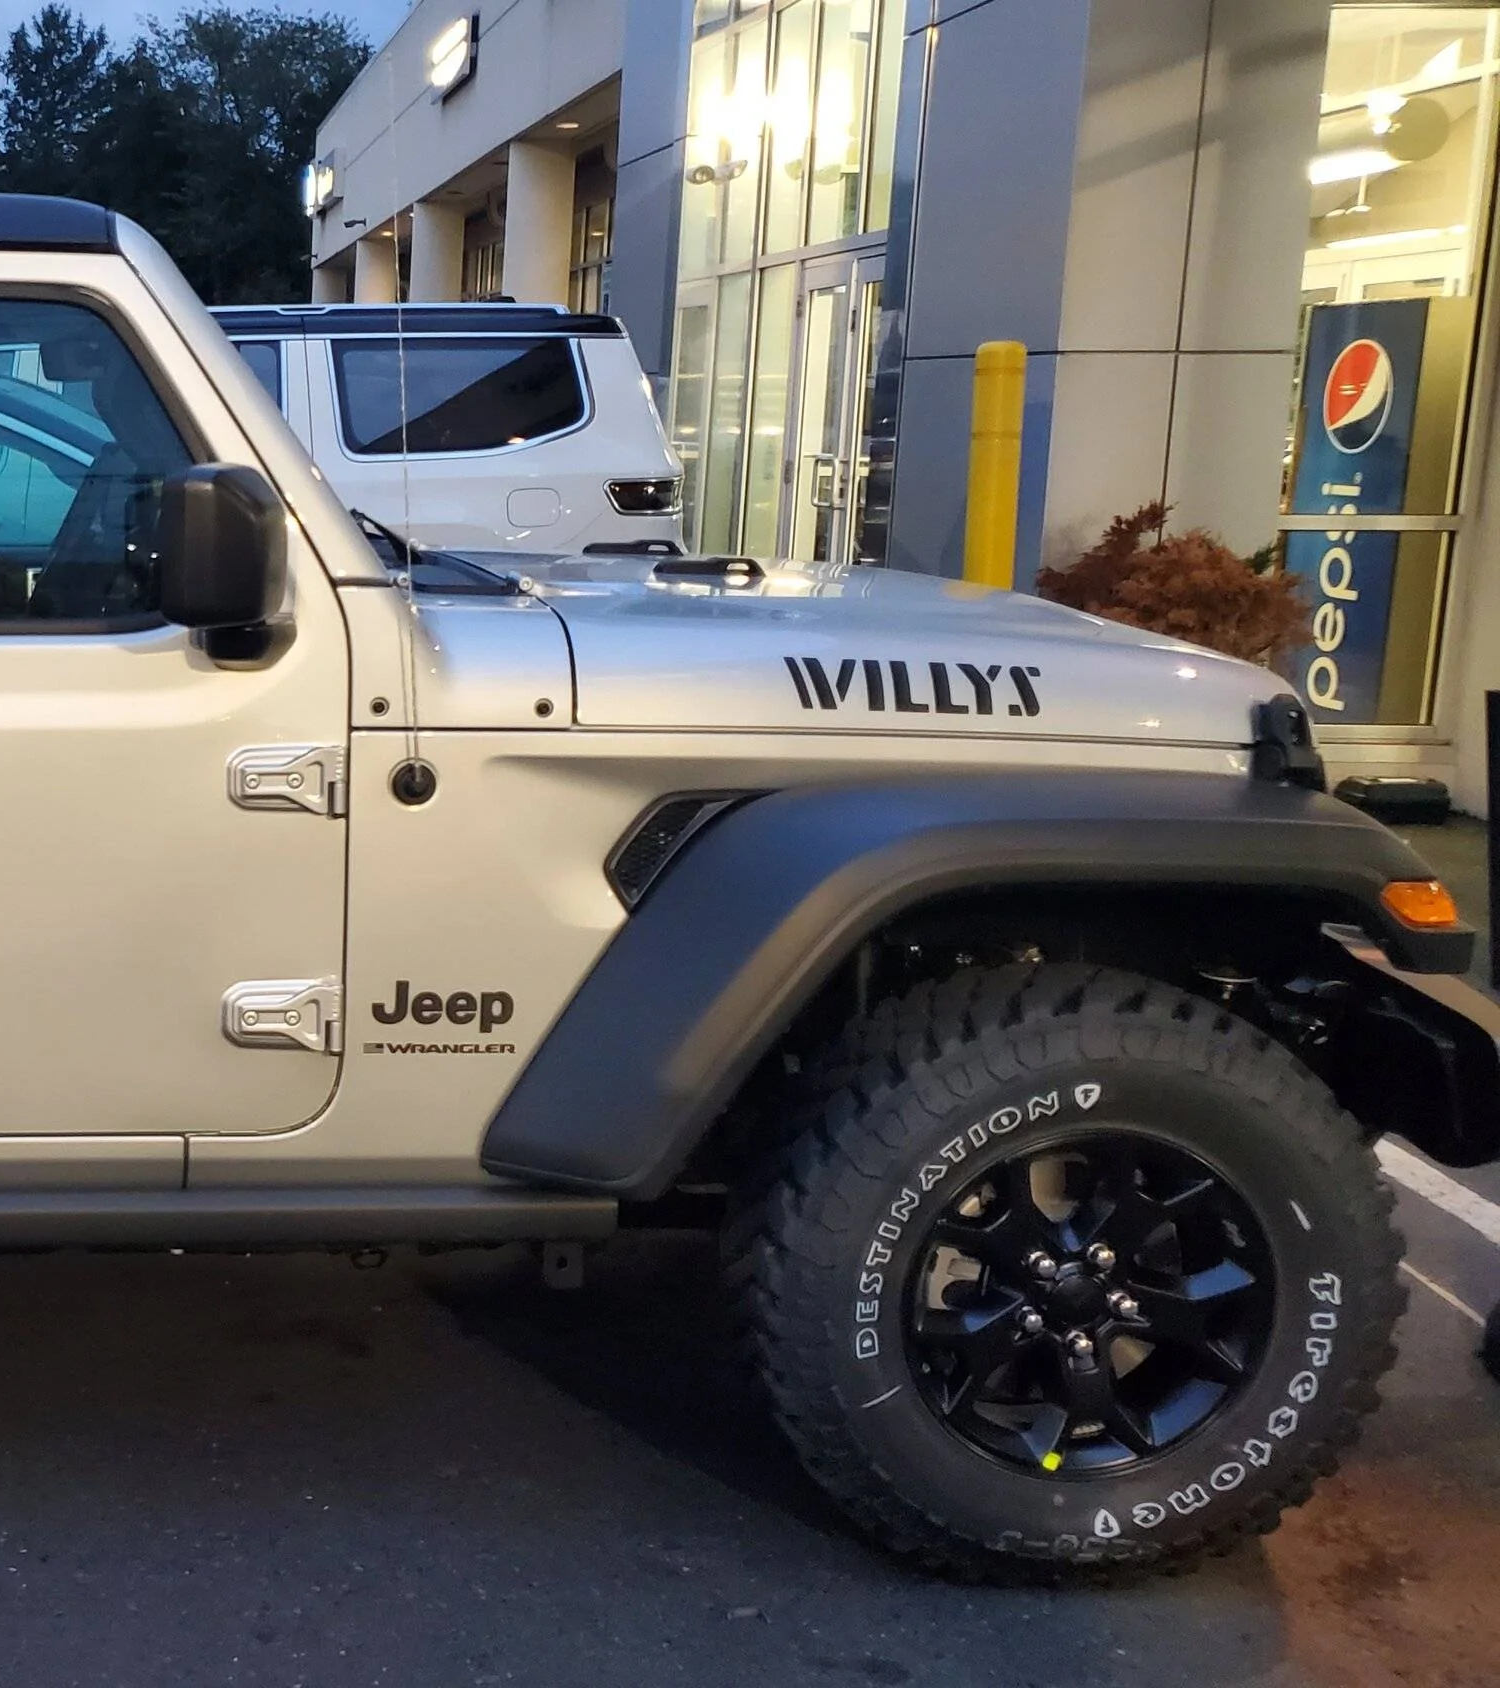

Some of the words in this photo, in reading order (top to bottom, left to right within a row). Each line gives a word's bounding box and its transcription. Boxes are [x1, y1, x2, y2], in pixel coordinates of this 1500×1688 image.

[1306, 482, 1362, 711] pepsi
[783, 656, 1041, 717] WILLYS
[371, 980, 514, 1034] Jeep
[386, 1043, 517, 1055] WRANGLER
[855, 1090, 1060, 1361] DESTINATION
